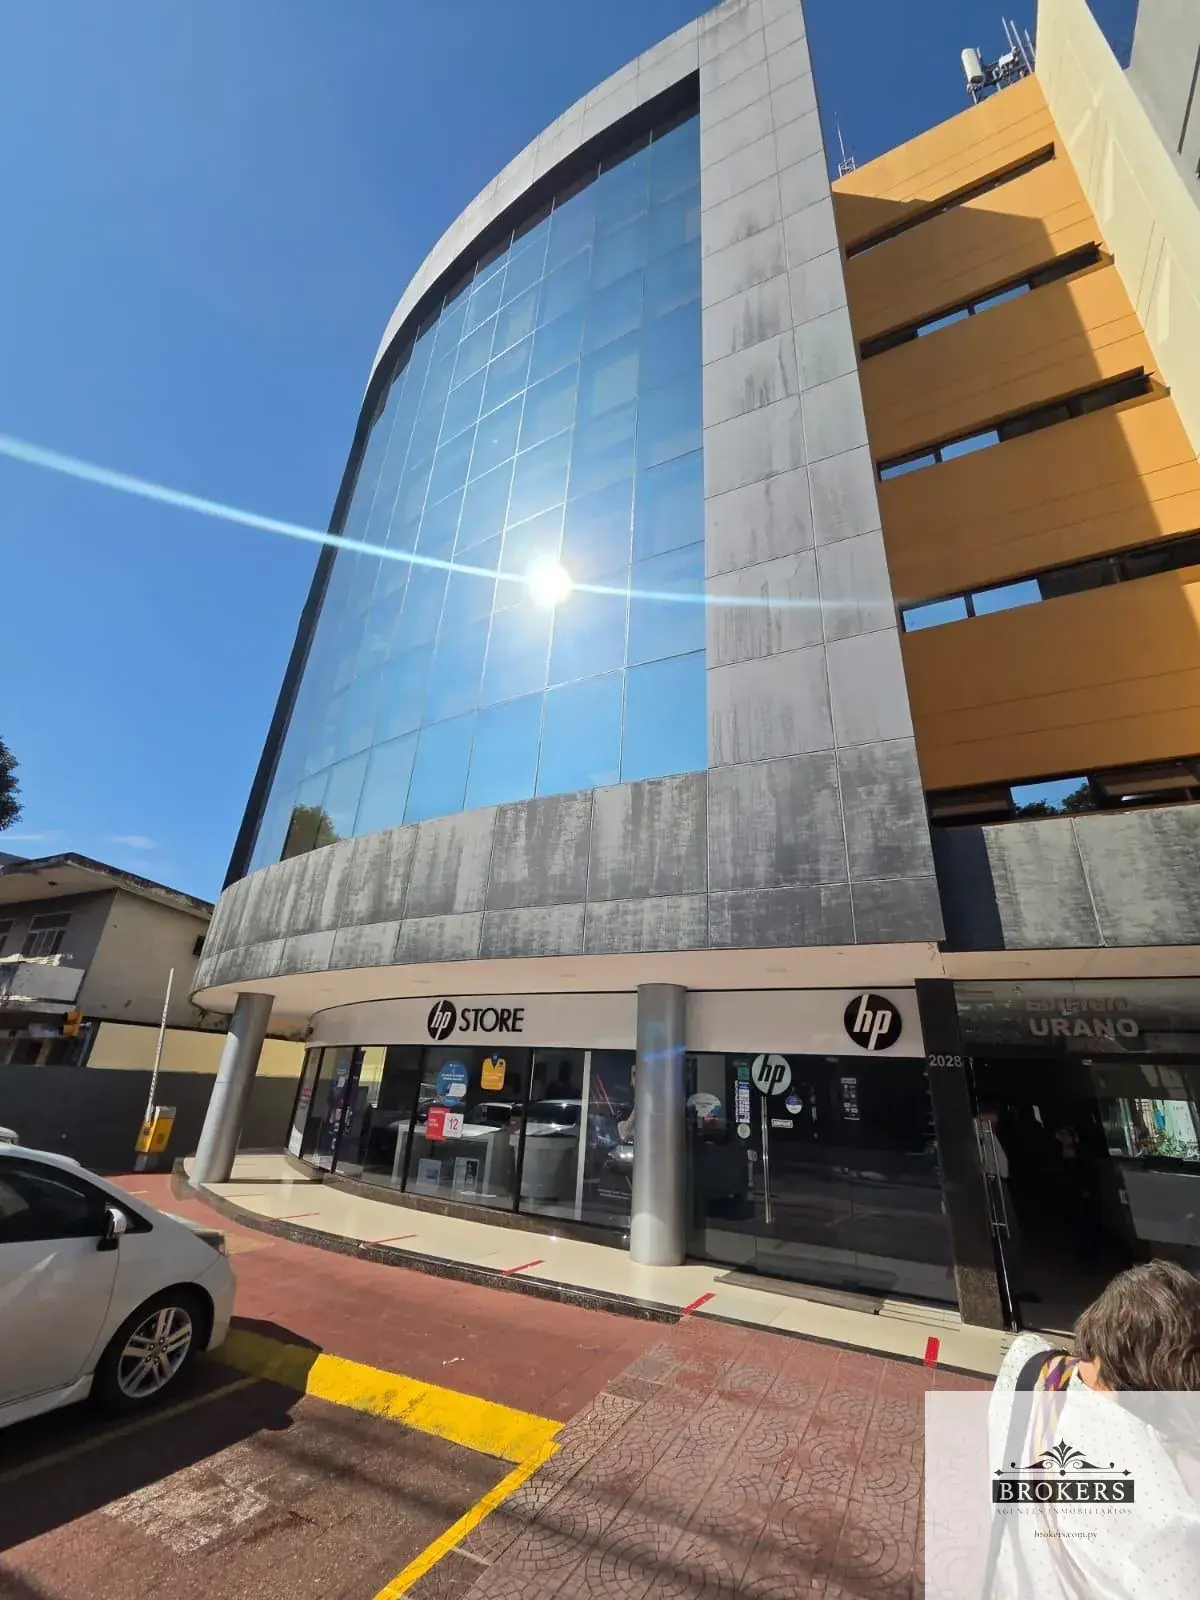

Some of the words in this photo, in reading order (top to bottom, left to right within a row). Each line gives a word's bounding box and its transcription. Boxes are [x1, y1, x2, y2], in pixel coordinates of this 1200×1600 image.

[430, 1000, 452, 1040] hp
[459, 1008, 524, 1032] STORE
[853, 994, 893, 1050] hp
[1028, 1018, 1139, 1037] URANO
[758, 1054, 786, 1096] hp
[929, 1055, 962, 1067] 2028
[449, 1118, 459, 1130] 12
